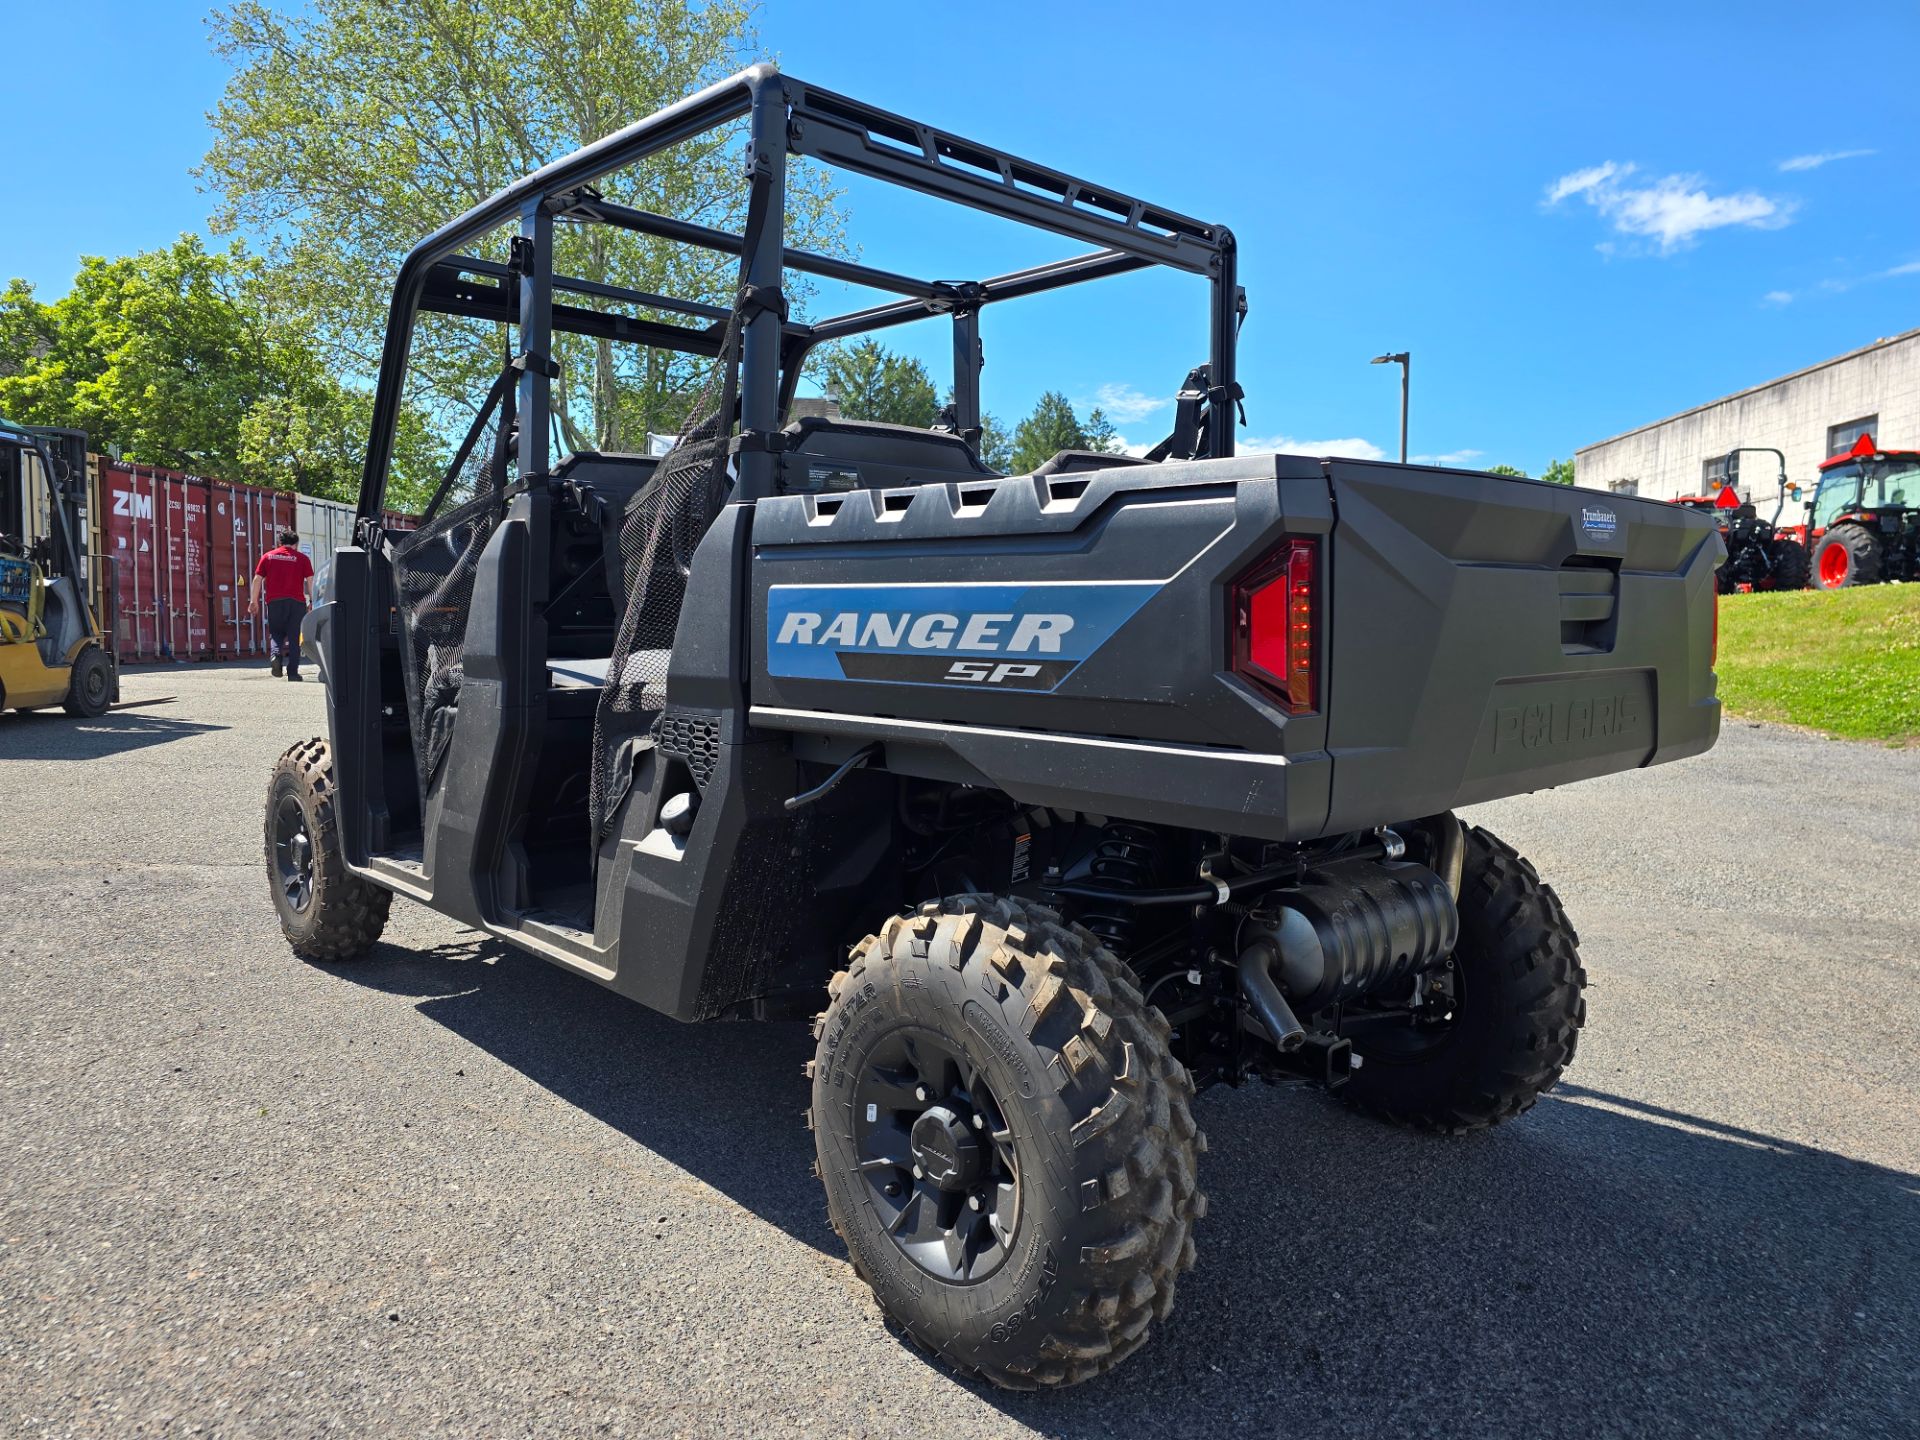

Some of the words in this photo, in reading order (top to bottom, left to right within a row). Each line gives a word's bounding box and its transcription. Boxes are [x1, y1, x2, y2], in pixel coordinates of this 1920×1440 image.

[112, 489, 152, 520] ZIM
[775, 612, 1075, 653] RANGER
[943, 661, 1042, 683] SP
[1491, 692, 1641, 755] POLARIS
